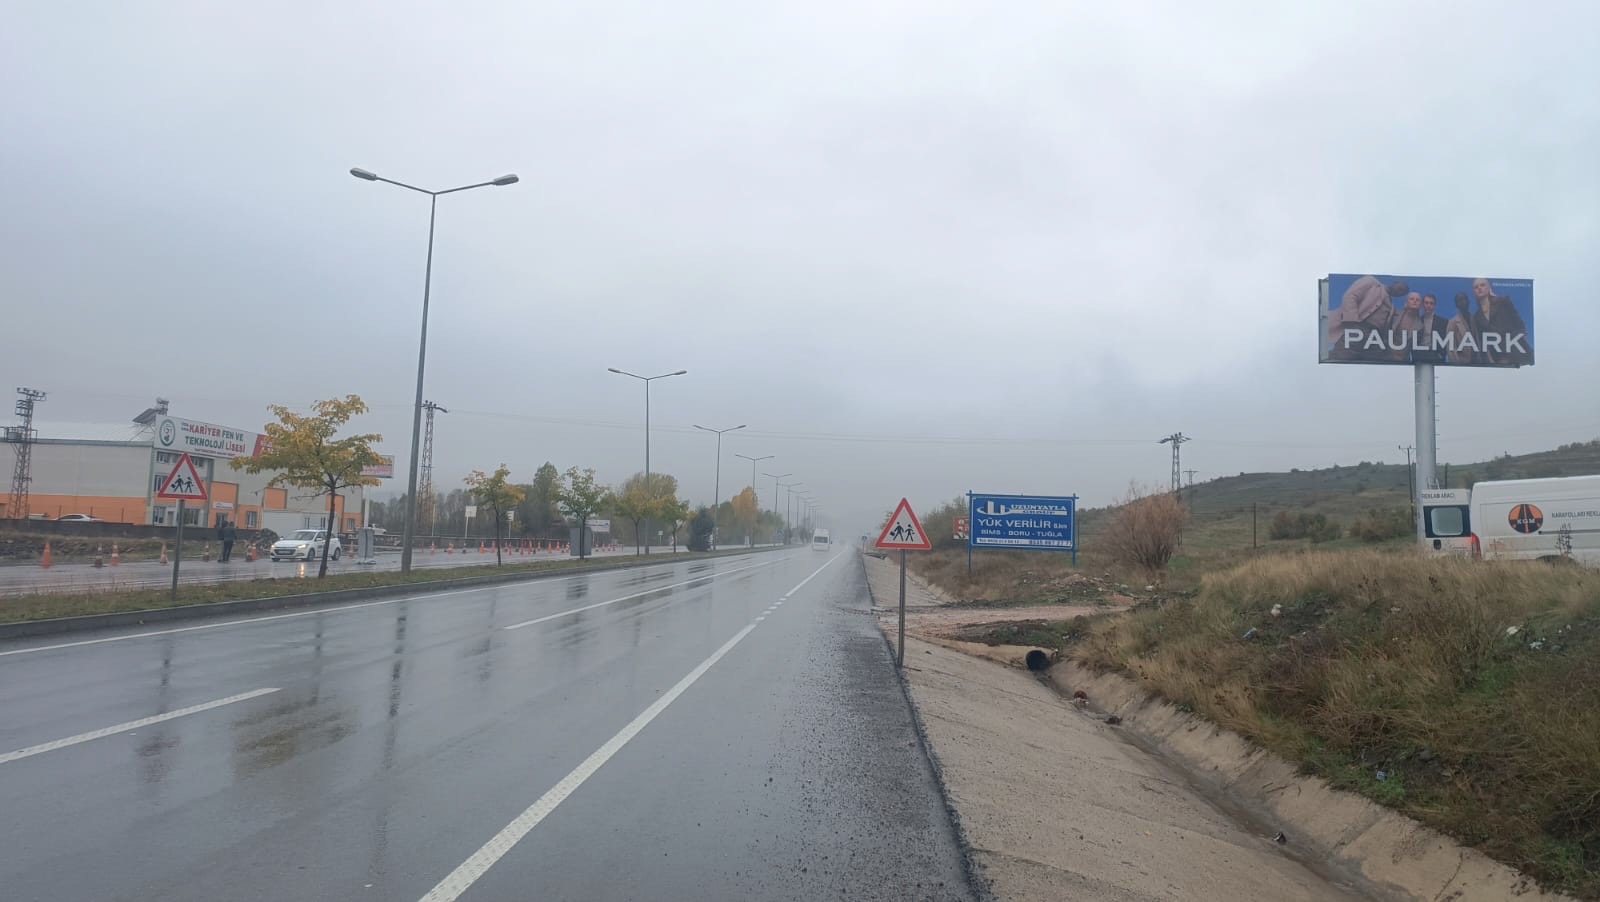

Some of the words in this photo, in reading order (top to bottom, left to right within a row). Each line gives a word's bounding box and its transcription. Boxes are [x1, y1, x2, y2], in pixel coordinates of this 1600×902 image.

[1344, 328, 1526, 354] PAULMARK
[190, 424, 220, 438] KARİYER
[222, 430, 233, 440] FEN
[236, 432, 244, 442] VE
[185, 436, 224, 449] TEKNOLOJİ
[226, 443, 245, 453] LİSESİ
[978, 517, 1002, 527] YÜK
[1006, 518, 1051, 528] VERİLİR
